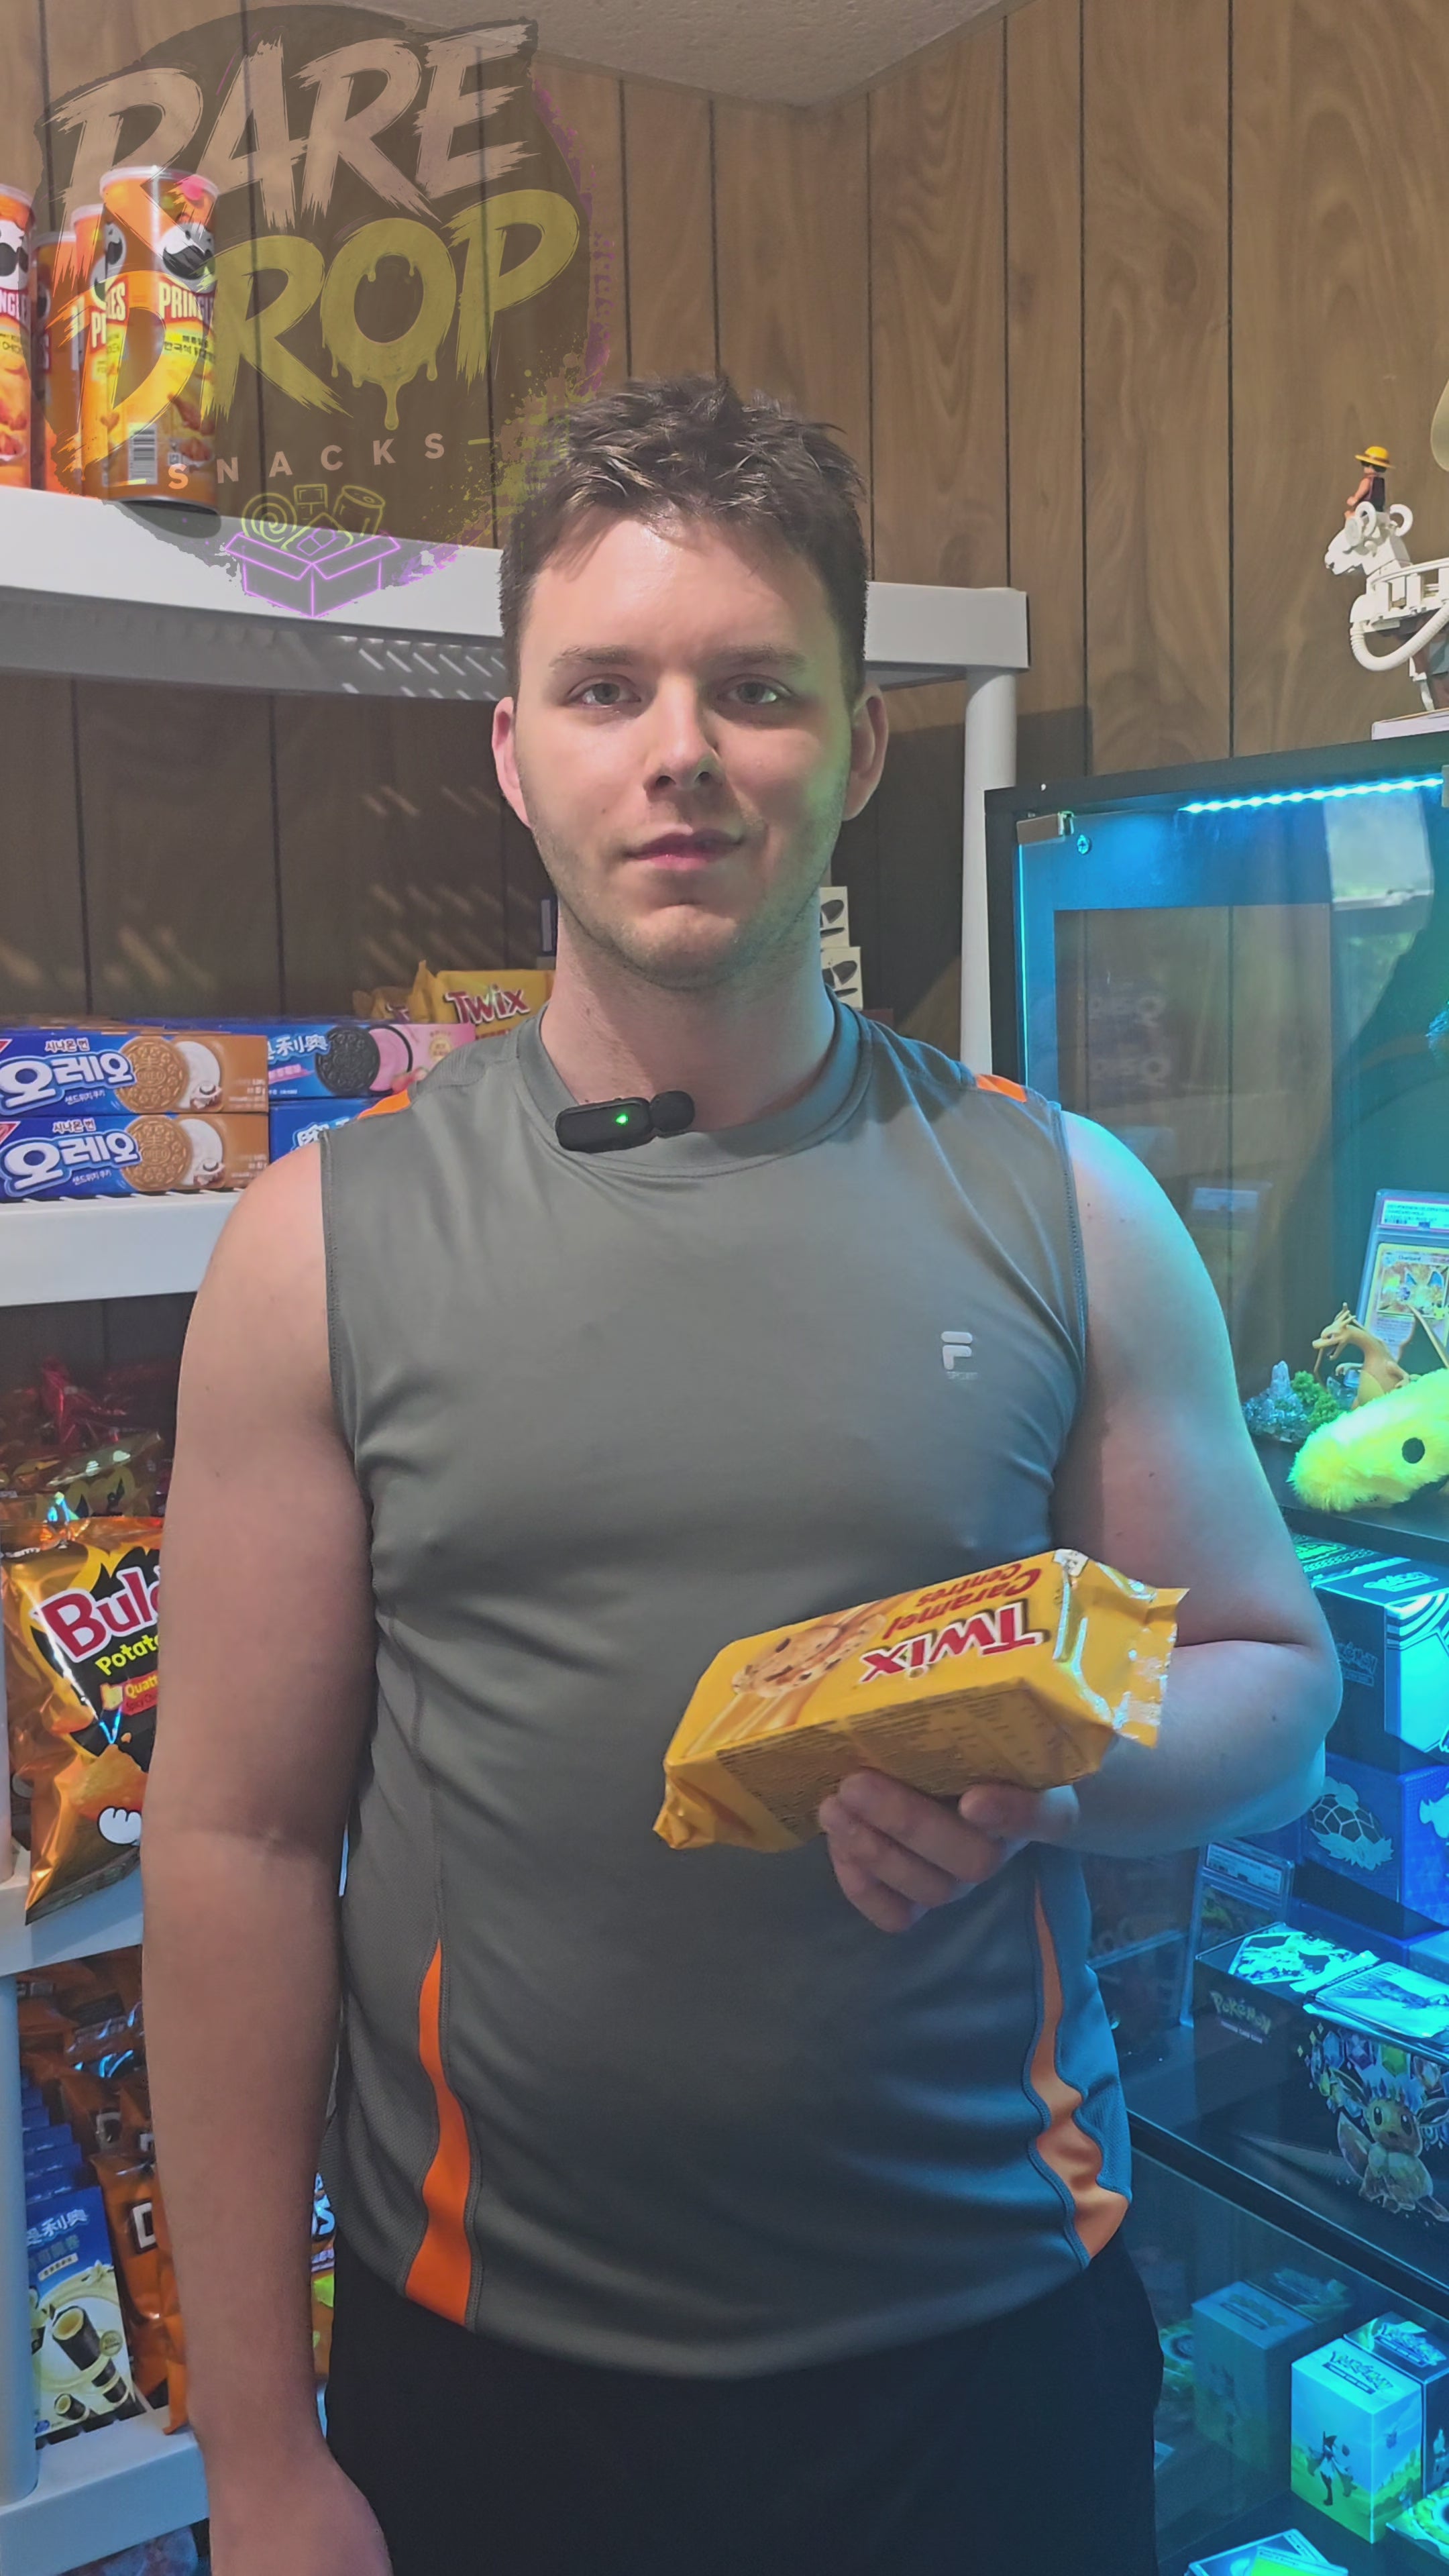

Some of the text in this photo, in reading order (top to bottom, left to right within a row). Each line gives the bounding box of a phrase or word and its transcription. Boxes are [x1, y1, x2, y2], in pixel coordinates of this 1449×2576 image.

[0, 1053, 133, 1109] 오레오
[4, 1132, 138, 1190] 오레오
[881, 1568, 1042, 1640] Caramel
[915, 1563, 1022, 1609] Centres
[125, 1674, 158, 1699] Quatt
